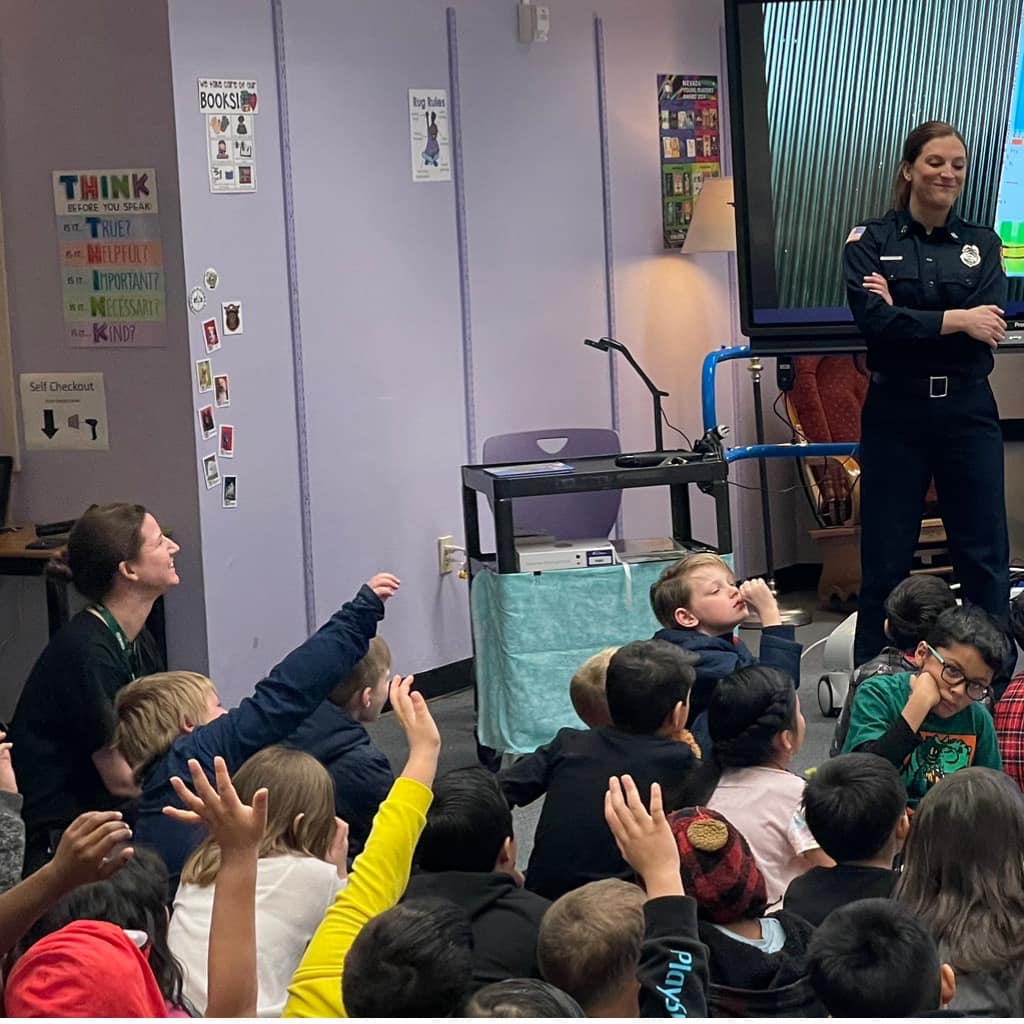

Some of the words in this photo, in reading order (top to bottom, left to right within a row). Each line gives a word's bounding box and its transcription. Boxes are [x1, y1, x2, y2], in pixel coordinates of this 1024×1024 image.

[200, 91, 240, 110] BOOKS!
[59, 173, 150, 200] THINK
[67, 203, 99, 213] BEFORE
[103, 203, 120, 212] YOU
[85, 217, 131, 239] TRUE?
[87, 243, 148, 264] HELPFUL?
[92, 270, 160, 292] IMPORTANT?
[90, 296, 160, 318] NECESSARY?
[92, 322, 136, 343] KIND?
[30, 381, 47, 392] Self
[50, 380, 95, 392] Checkout
